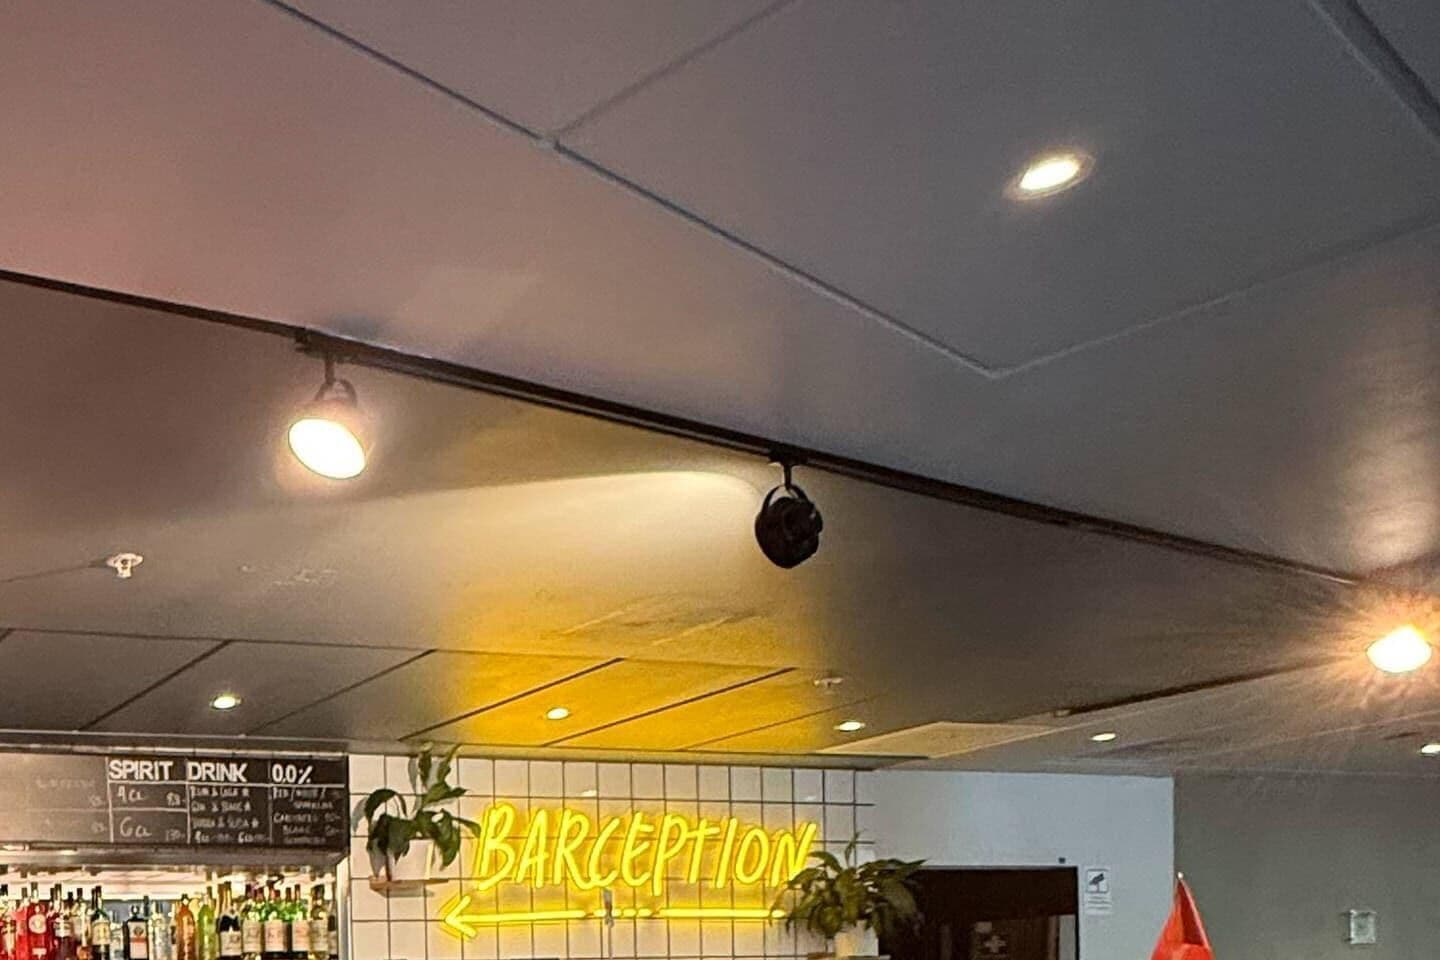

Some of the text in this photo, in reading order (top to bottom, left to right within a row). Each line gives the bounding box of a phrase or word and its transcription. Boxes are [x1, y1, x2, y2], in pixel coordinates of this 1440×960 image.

[109, 760, 173, 781] SPIRIT
[187, 761, 247, 783] DRINK
[476, 803, 817, 896] BARCEPTION
